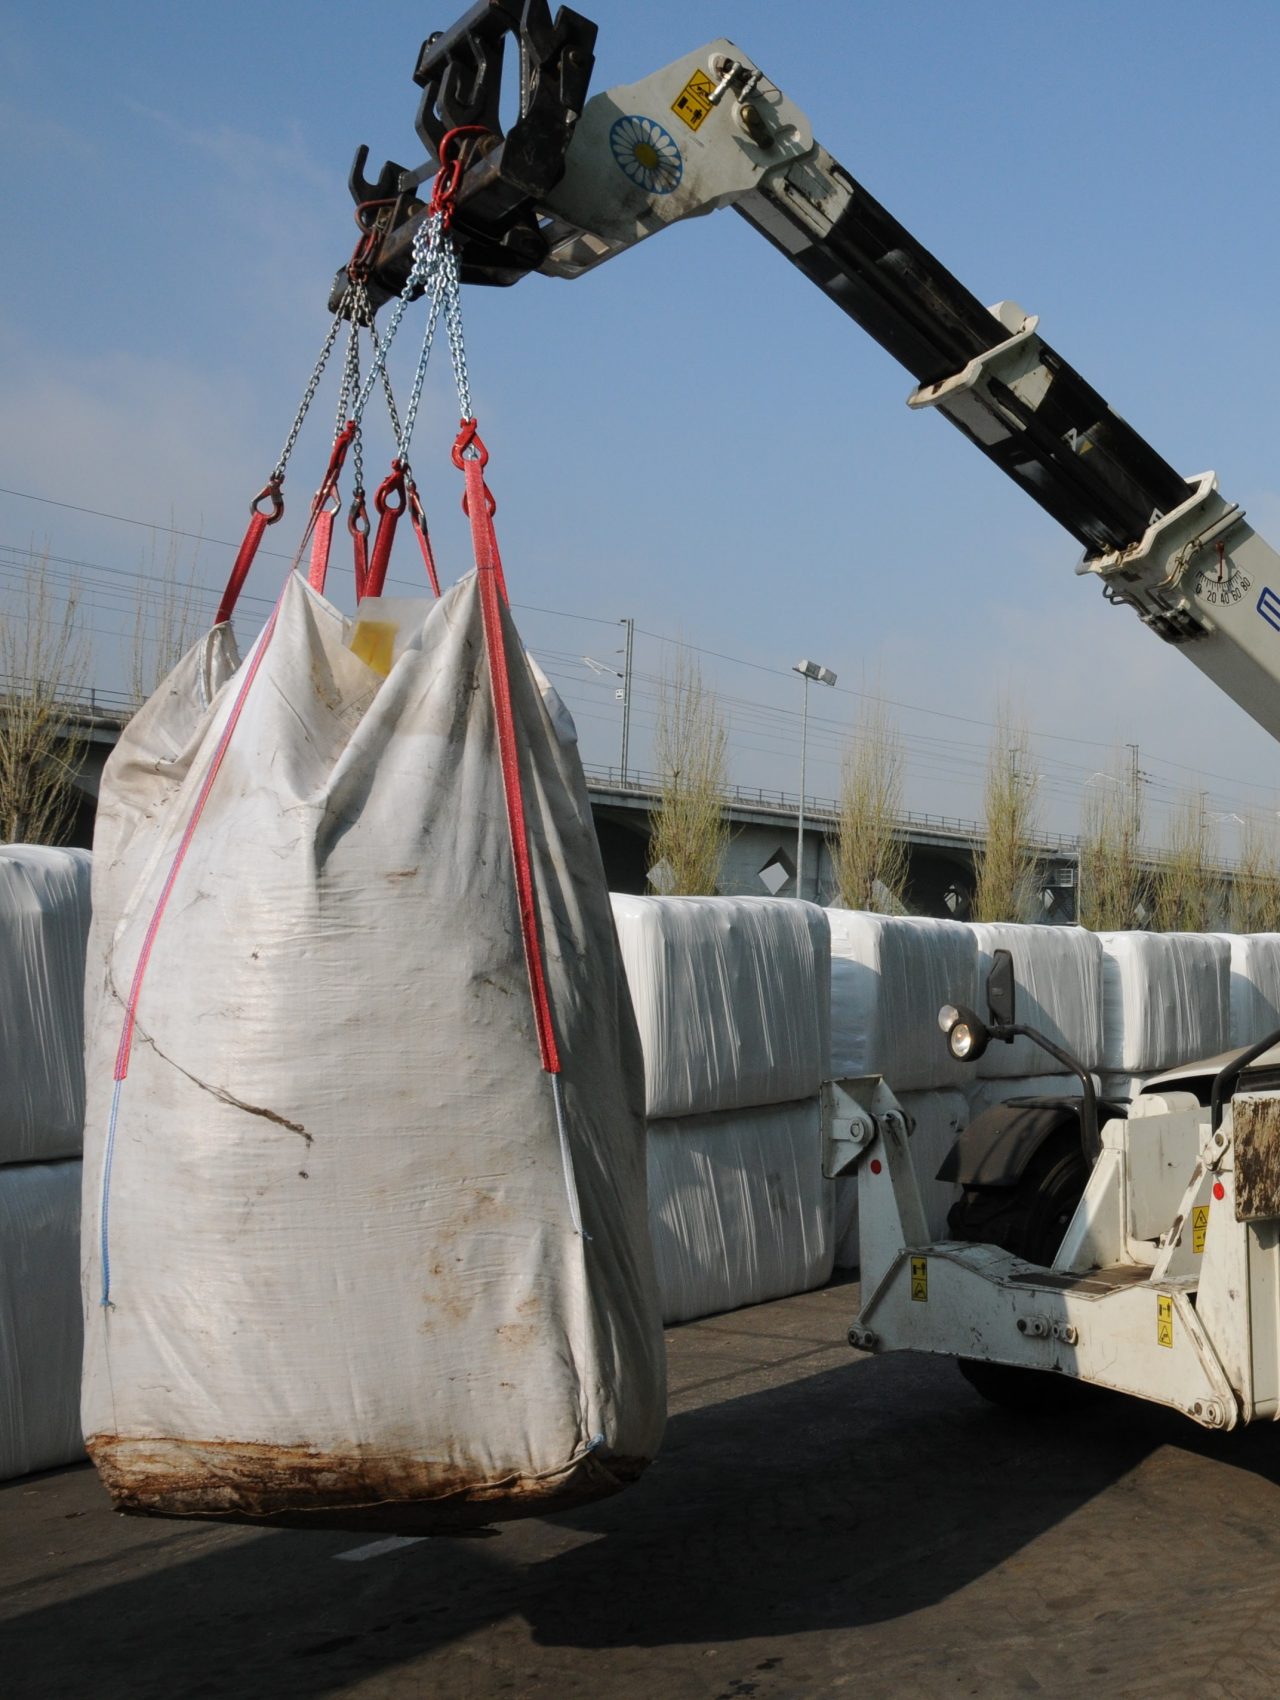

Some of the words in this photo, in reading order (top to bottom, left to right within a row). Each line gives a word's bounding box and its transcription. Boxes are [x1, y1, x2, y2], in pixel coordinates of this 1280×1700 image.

[1196, 583, 1202, 594] 0
[1207, 590, 1217, 603] 20
[1220, 592, 1230, 605] 40
[1231, 587, 1241, 601] 60
[1240, 577, 1250, 591] 80
